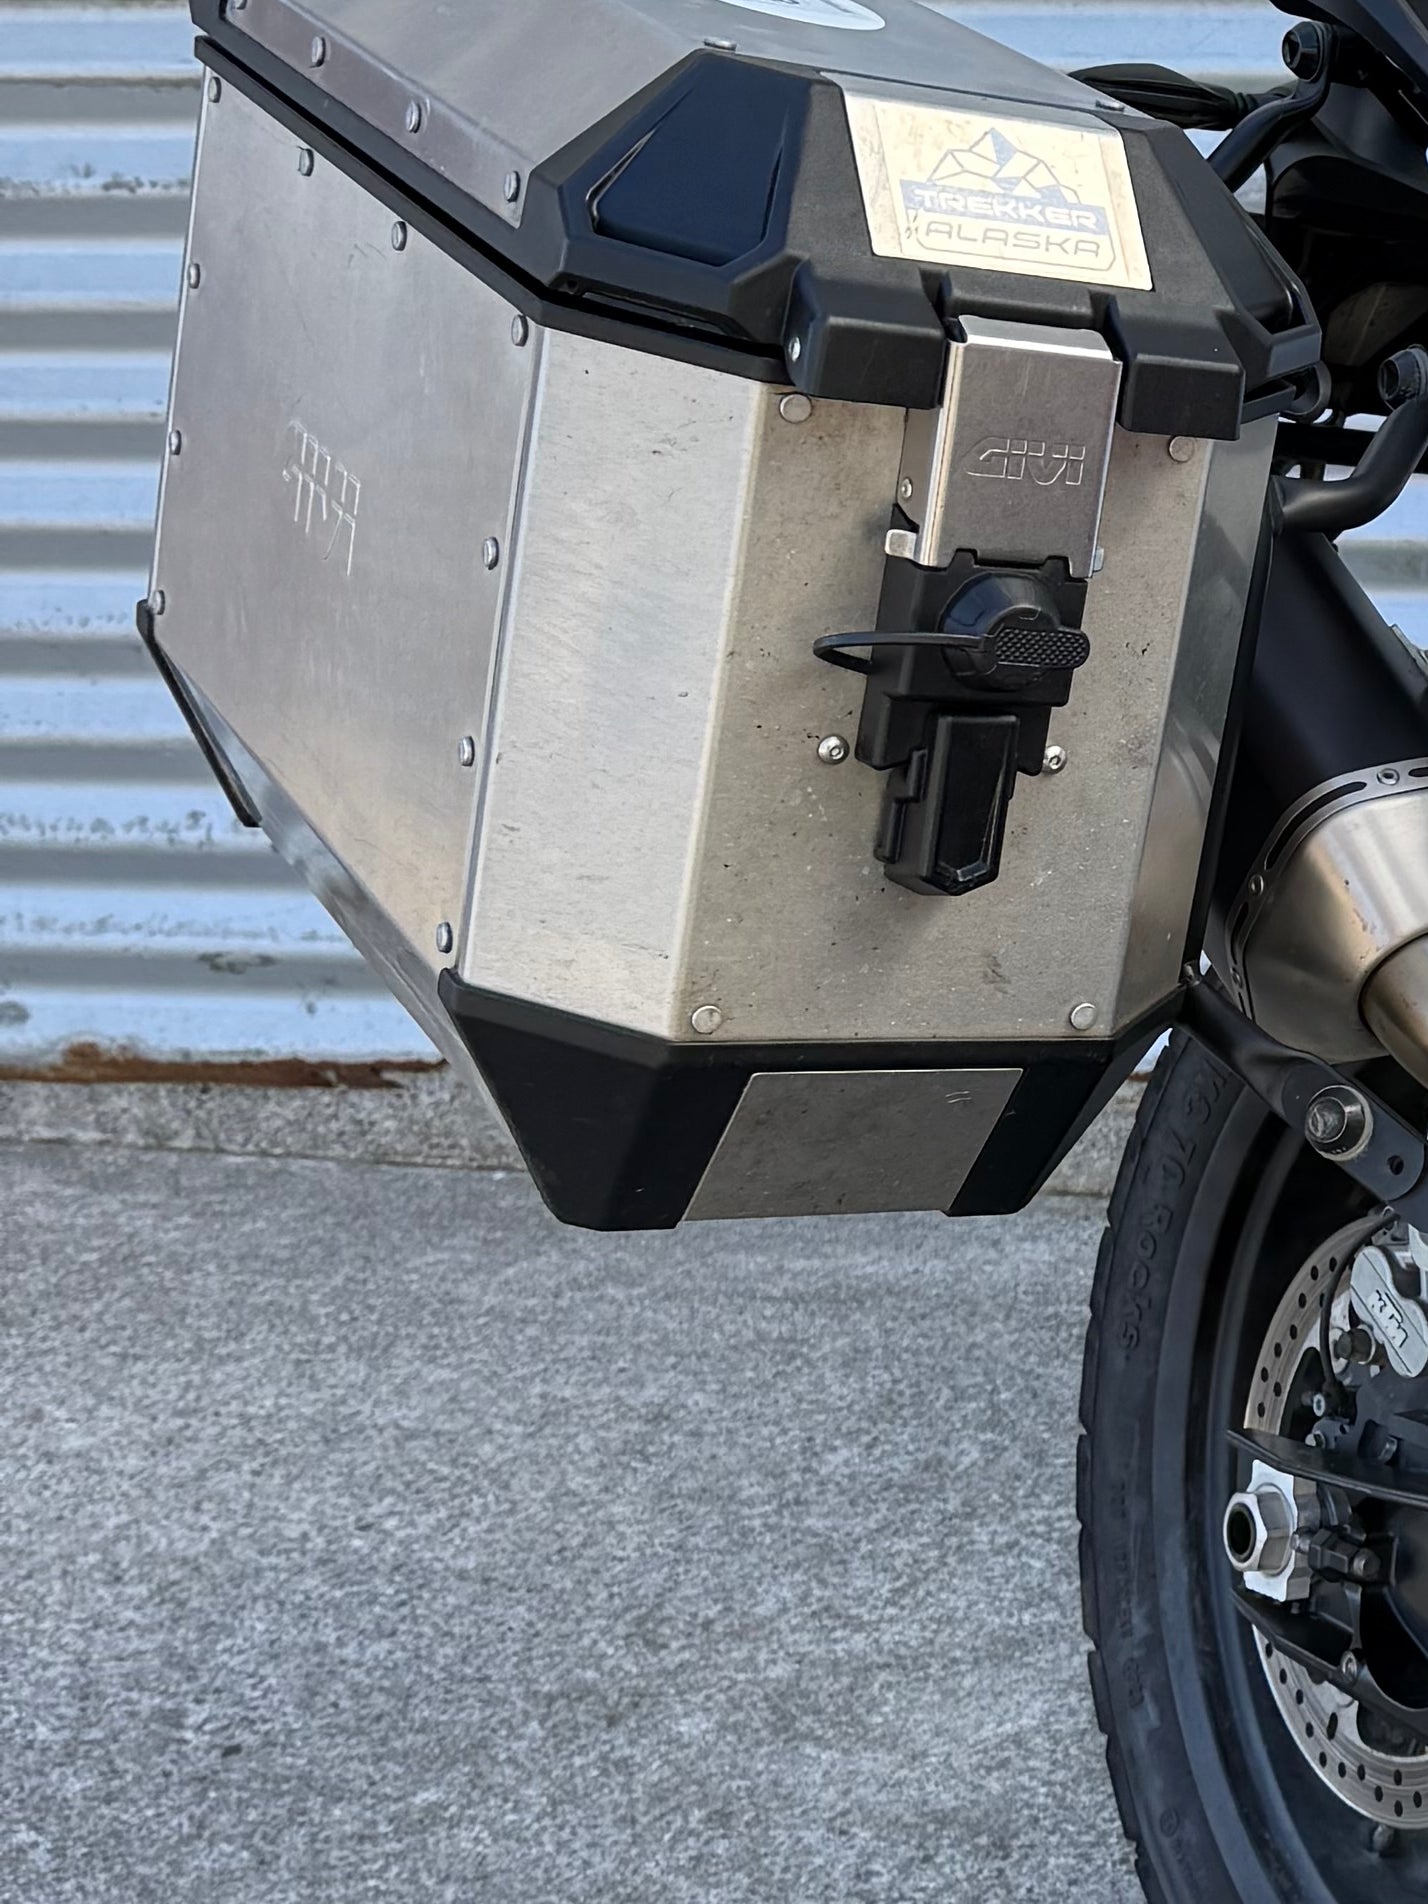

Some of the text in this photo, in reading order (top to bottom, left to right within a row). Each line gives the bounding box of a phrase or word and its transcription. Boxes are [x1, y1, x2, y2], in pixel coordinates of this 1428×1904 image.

[911, 188, 1099, 230] TREKKER
[924, 220, 1101, 258] ALASKA
[965, 436, 1086, 486] GIVI
